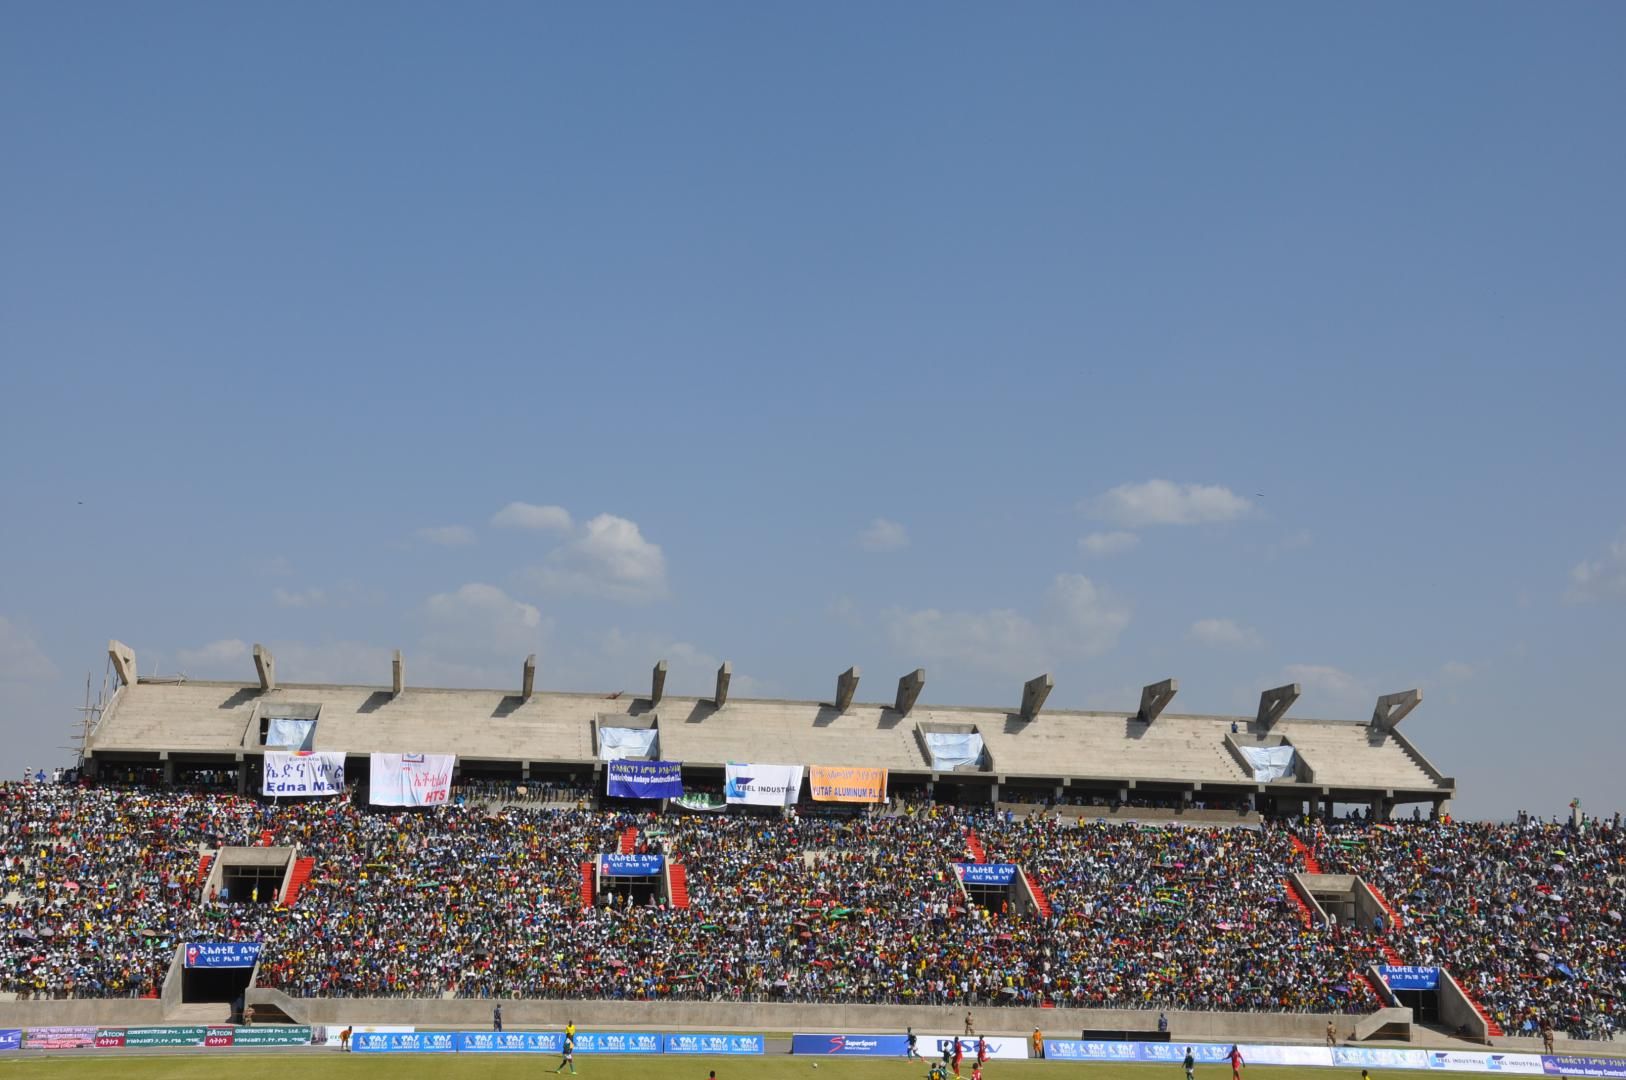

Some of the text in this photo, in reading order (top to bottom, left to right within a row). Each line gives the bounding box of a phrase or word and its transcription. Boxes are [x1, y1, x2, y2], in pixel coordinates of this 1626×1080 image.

[266, 781, 344, 793] Edna Mall
[812, 786, 832, 796] YUTAF
[834, 787, 866, 797] ALUMINUM
[425, 789, 446, 803] HTS
[846, 1039, 877, 1047] SuperSport
